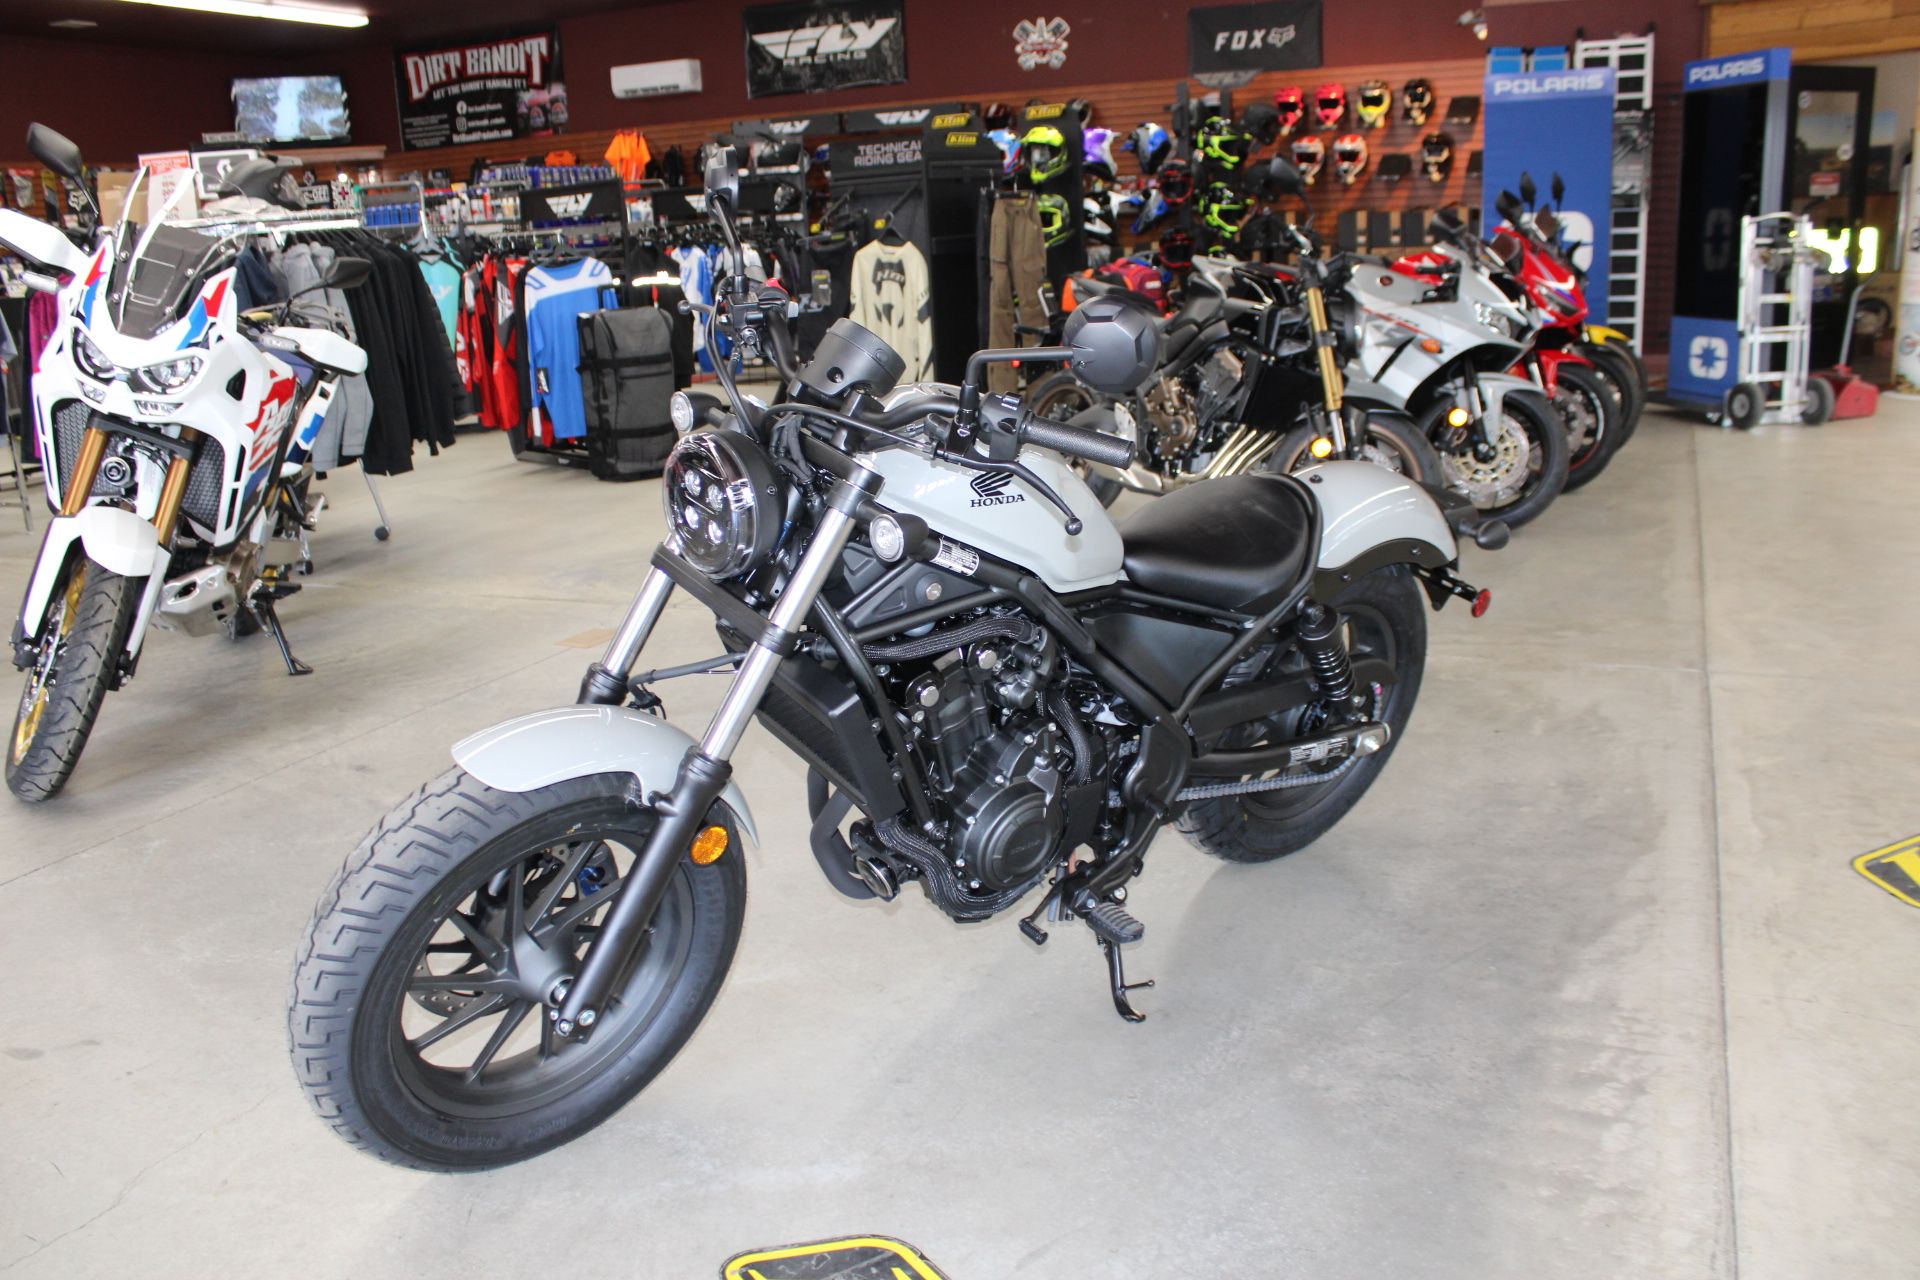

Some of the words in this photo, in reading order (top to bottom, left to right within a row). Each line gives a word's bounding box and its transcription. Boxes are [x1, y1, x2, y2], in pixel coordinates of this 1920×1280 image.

[752, 18, 897, 59] FLY
[1214, 28, 1266, 52] FOX
[406, 50, 461, 100] DIRT
[465, 37, 548, 84] BANDIT
[783, 50, 867, 67] RACING
[1689, 57, 1765, 84] POLARIS
[1494, 74, 1604, 96] POLARIS
[874, 109, 930, 125] FLY
[854, 152, 894, 166] RIDING
[896, 150, 922, 163] GEA
[545, 192, 592, 214] FLY
[970, 494, 1025, 508] HONDA
